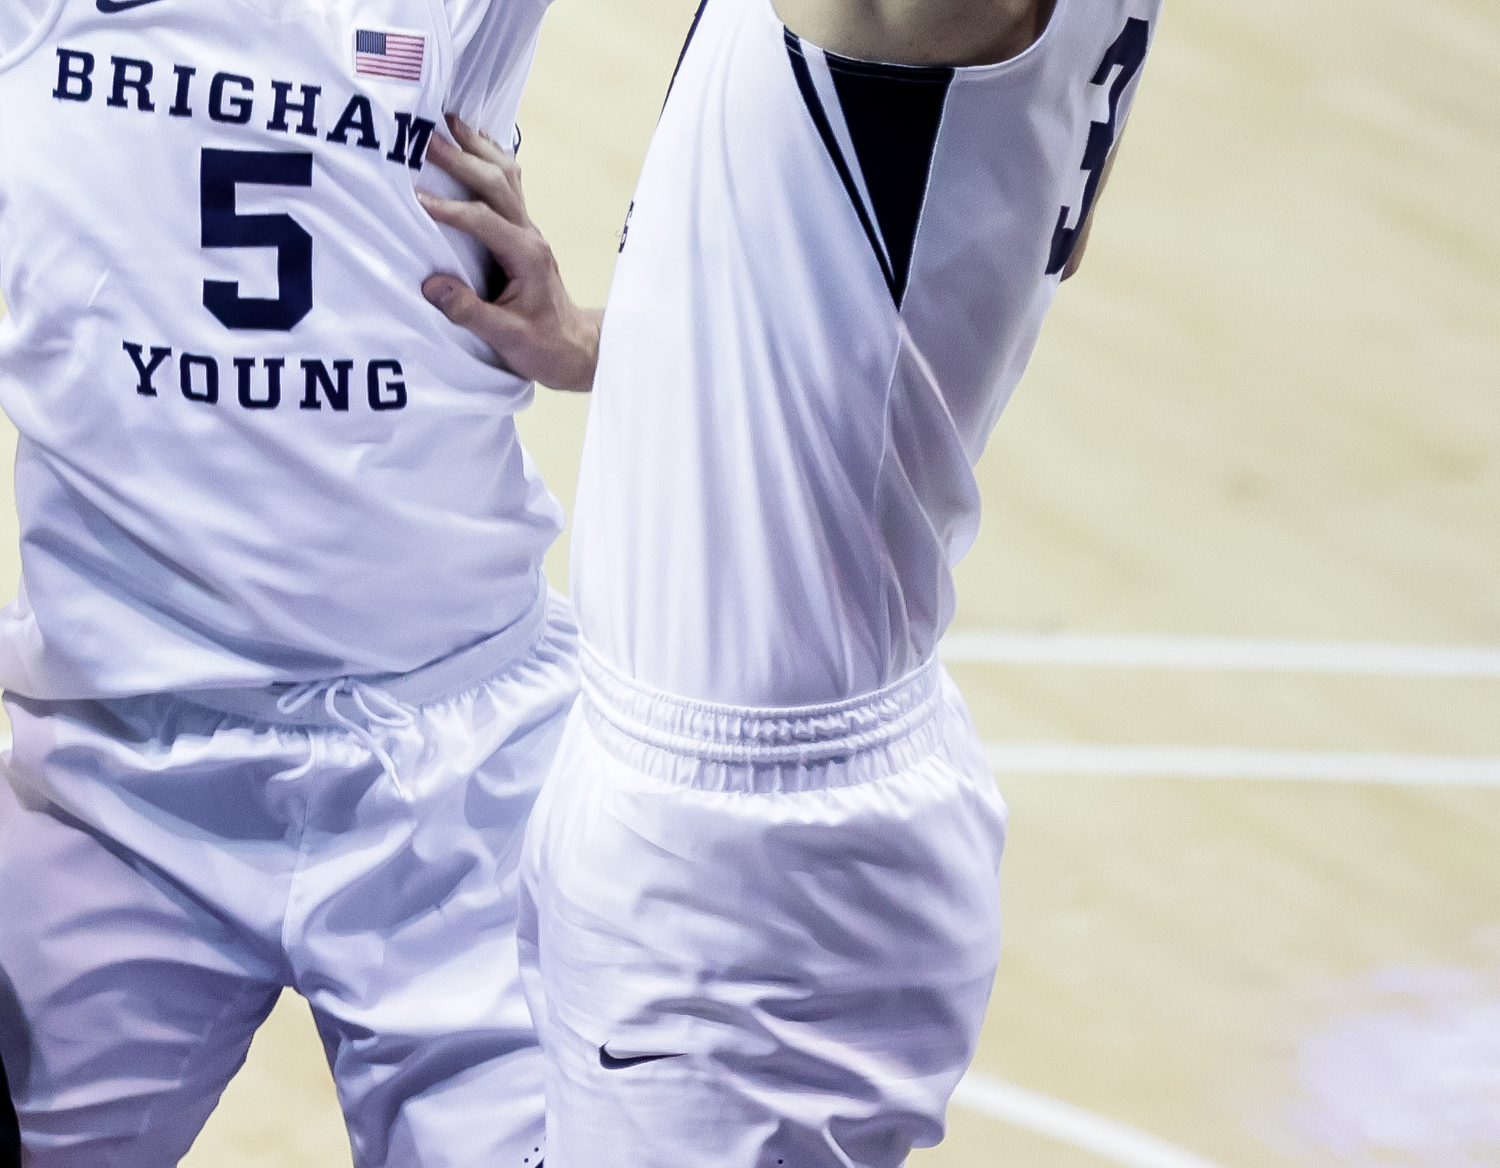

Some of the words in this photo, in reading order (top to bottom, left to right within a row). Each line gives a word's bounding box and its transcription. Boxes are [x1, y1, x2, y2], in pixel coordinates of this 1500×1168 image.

[52, 47, 436, 170] BRIGHAM
[1045, 17, 1150, 276] 3
[200, 147, 313, 332] 5
[122, 341, 408, 412] YOUNG
